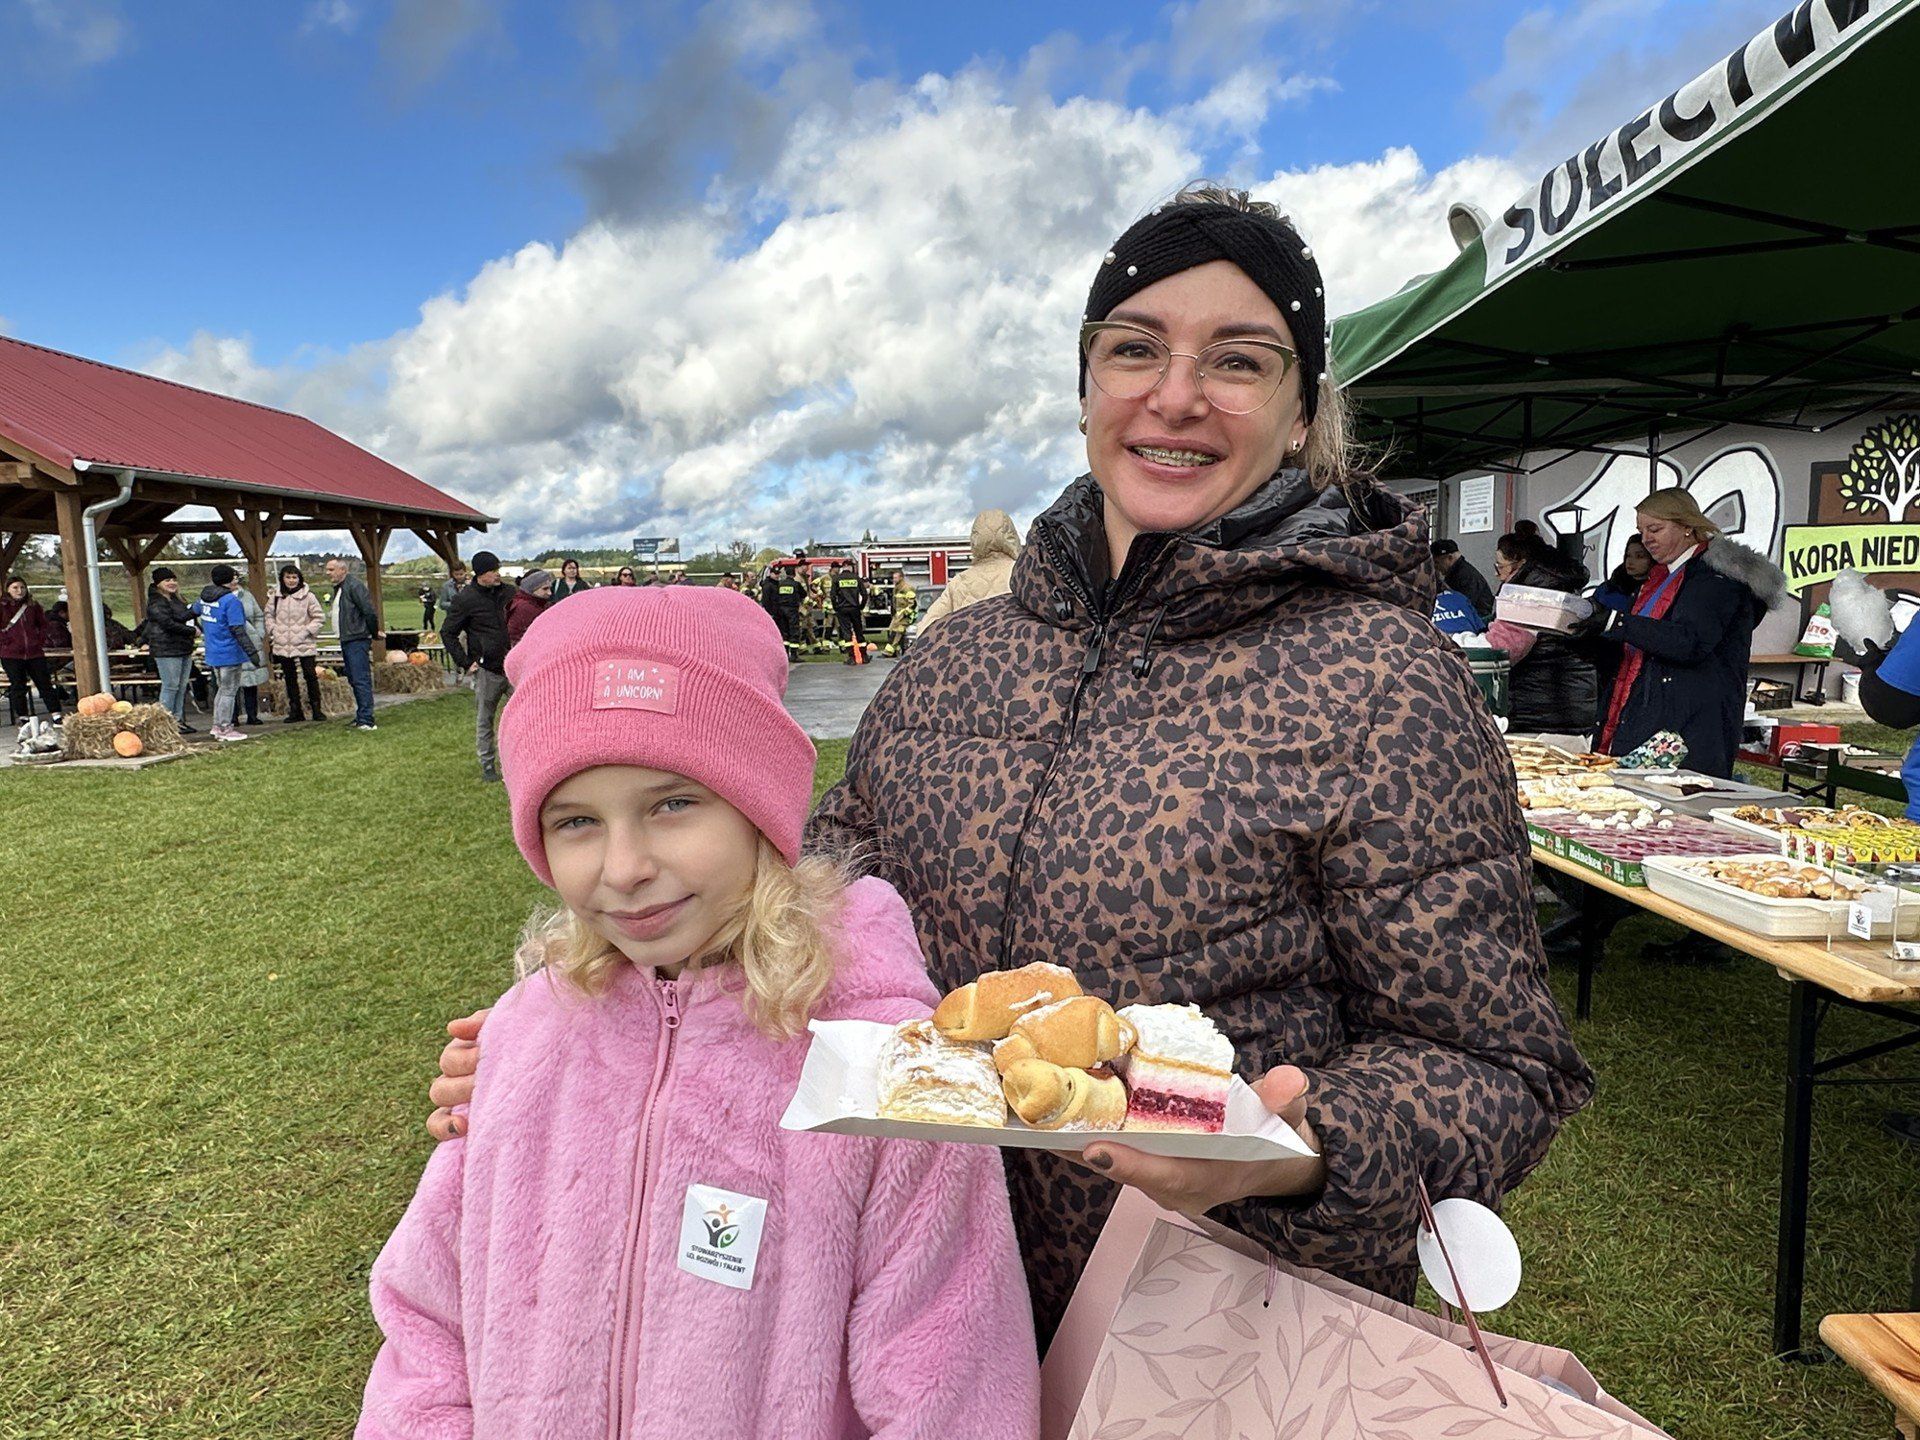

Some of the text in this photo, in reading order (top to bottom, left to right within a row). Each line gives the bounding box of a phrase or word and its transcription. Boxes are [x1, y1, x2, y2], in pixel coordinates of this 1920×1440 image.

[1789, 535, 1920, 579] KORA NIED
[617, 668, 645, 681] I AM
[603, 685, 611, 698] A
[723, 1263, 746, 1274] TALENT
